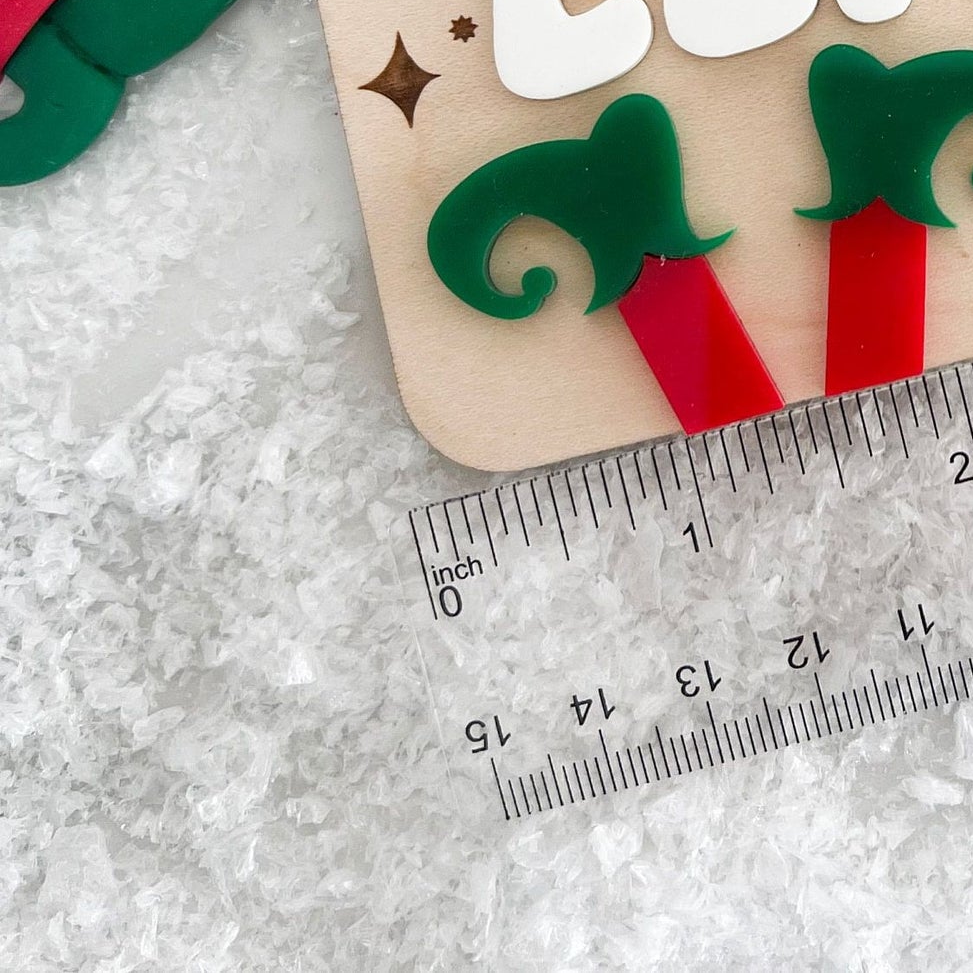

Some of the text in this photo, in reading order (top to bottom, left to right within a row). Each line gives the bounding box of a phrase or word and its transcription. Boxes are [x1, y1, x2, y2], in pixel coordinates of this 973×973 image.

[439, 585, 463, 617] 0
[682, 522, 700, 553] 1
[949, 451, 973, 484] 2
[431, 556, 483, 586] inch
[897, 604, 935, 641] 11
[783, 631, 830, 669] 12
[675, 660, 722, 697] 13
[570, 688, 616, 726] 14
[465, 715, 511, 753] 15
